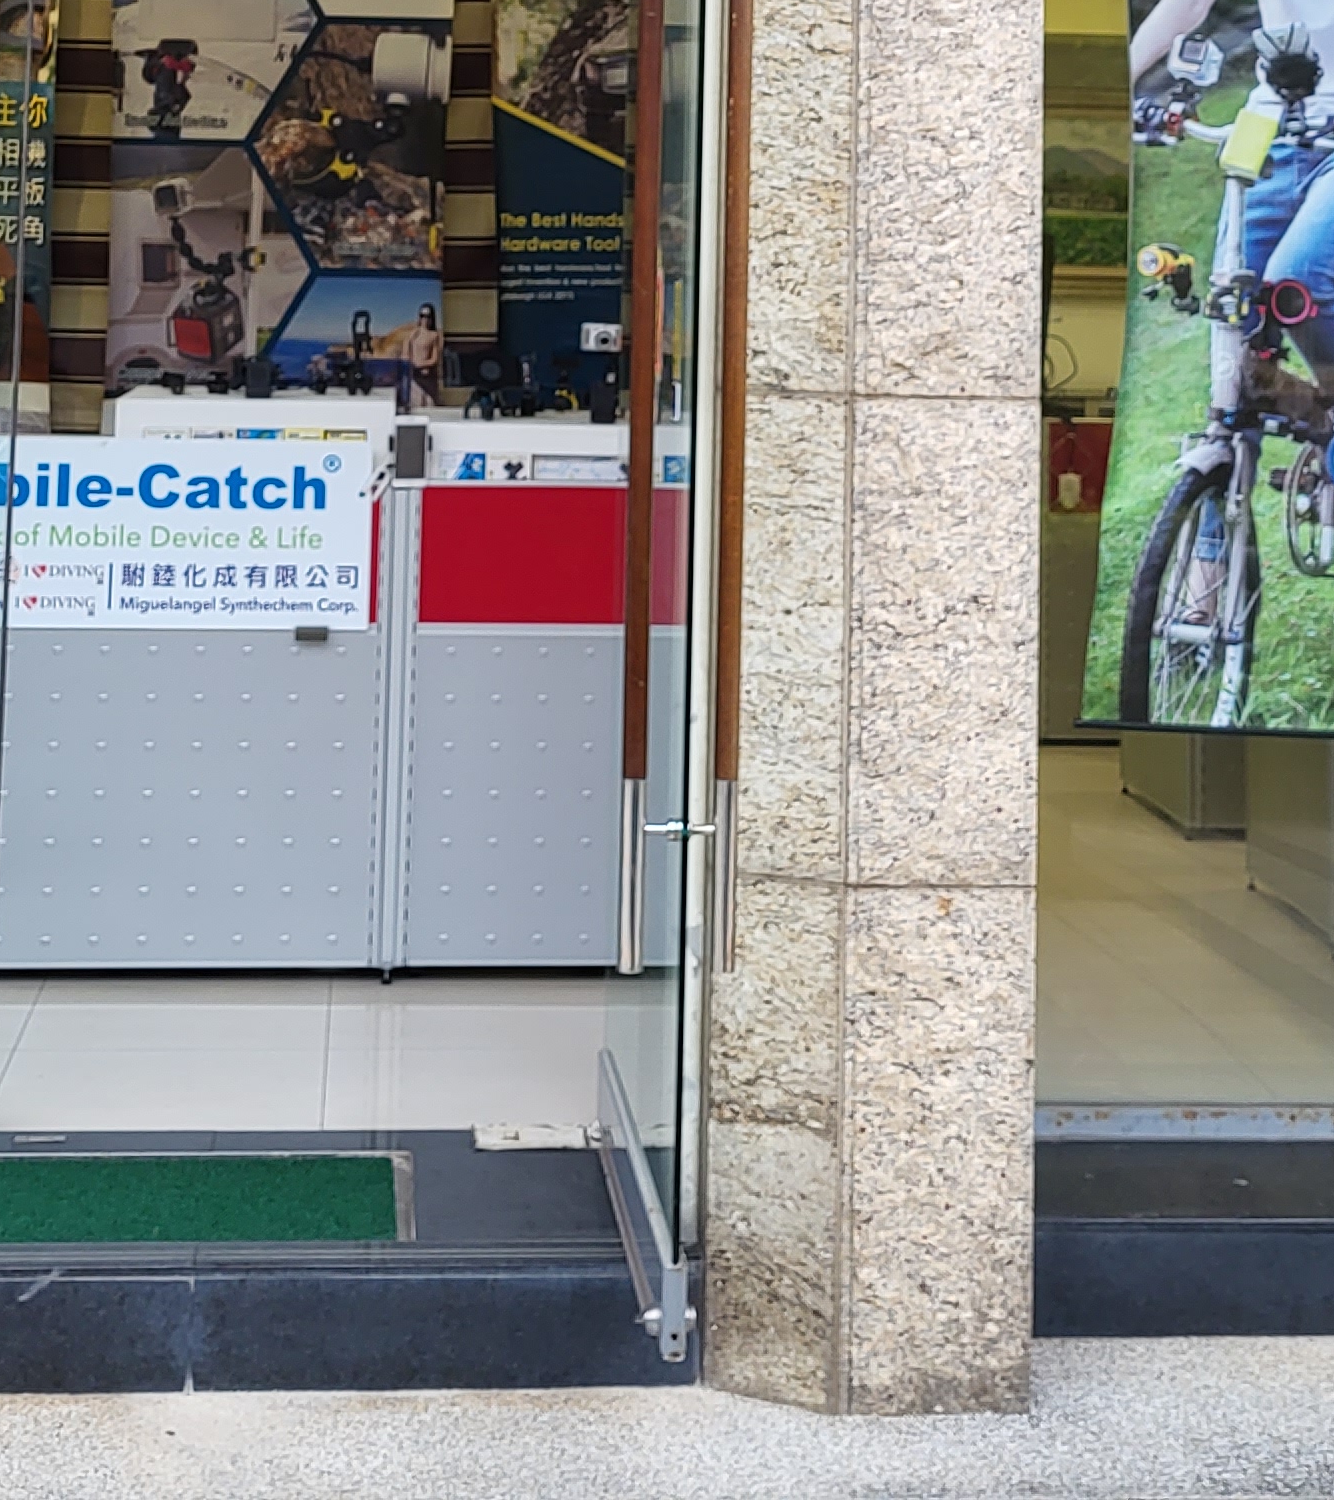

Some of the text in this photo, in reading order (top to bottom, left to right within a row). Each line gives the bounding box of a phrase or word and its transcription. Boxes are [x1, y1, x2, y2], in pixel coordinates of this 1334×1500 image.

[13, 522, 42, 546] of
[49, 523, 142, 547] Mobile
[150, 525, 241, 548] Device
[248, 525, 269, 549] &
[276, 525, 324, 549] Life
